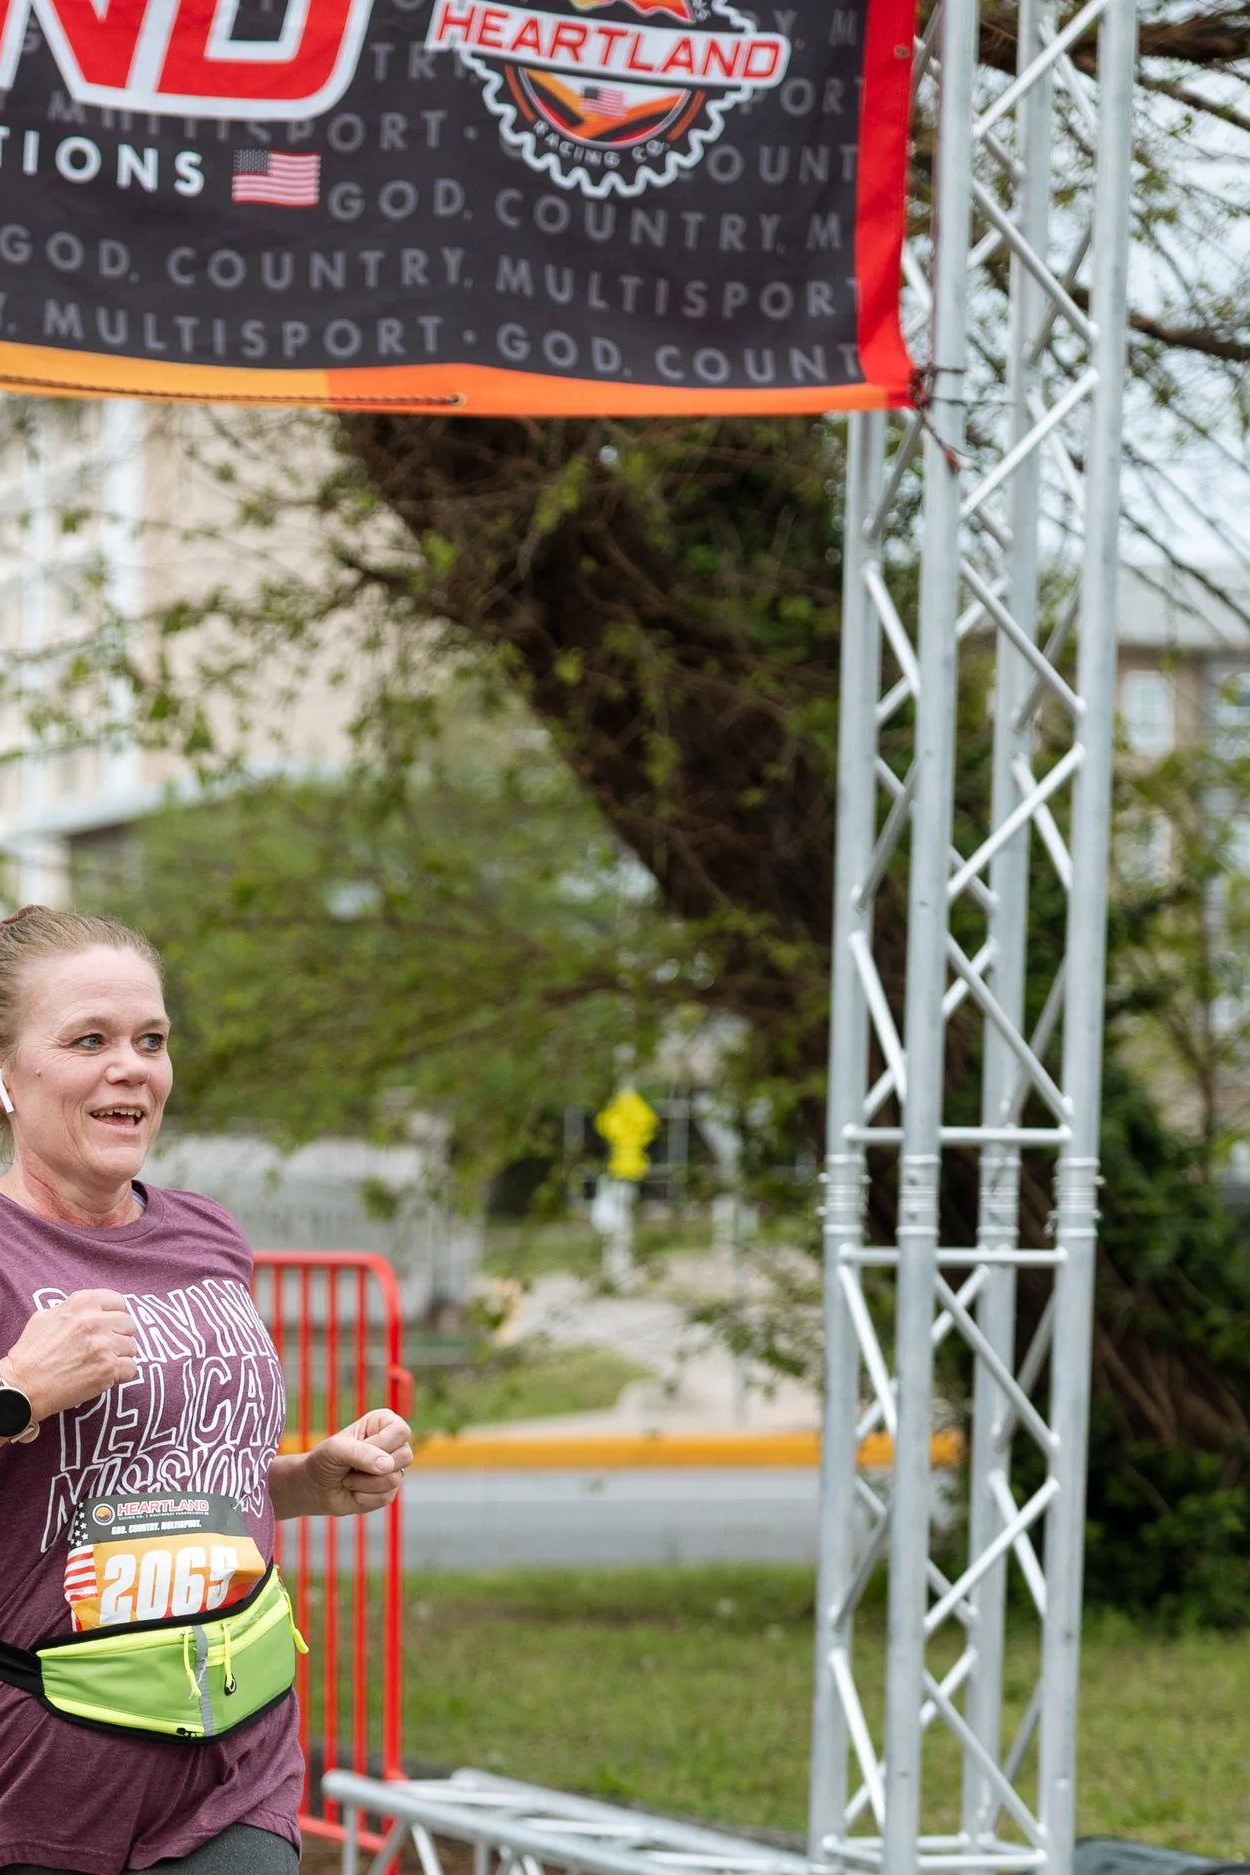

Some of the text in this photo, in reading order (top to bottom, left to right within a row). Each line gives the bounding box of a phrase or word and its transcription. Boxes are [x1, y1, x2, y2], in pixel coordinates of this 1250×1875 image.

[434, 4, 781, 80] HEARTLAND
[533, 118, 622, 168] RACING
[678, 143, 859, 186] OUNT
[327, 178, 474, 222] GOD,
[494, 187, 786, 255] COUNTRY,
[166, 245, 475, 291] COUNTRY,
[43, 298, 444, 358] MULTISPORT
[495, 321, 634, 378] GOD,
[653, 344, 862, 384] COUNT
[117, 1500, 209, 1517] HEARTLAND
[99, 1544, 239, 1625] 2065
